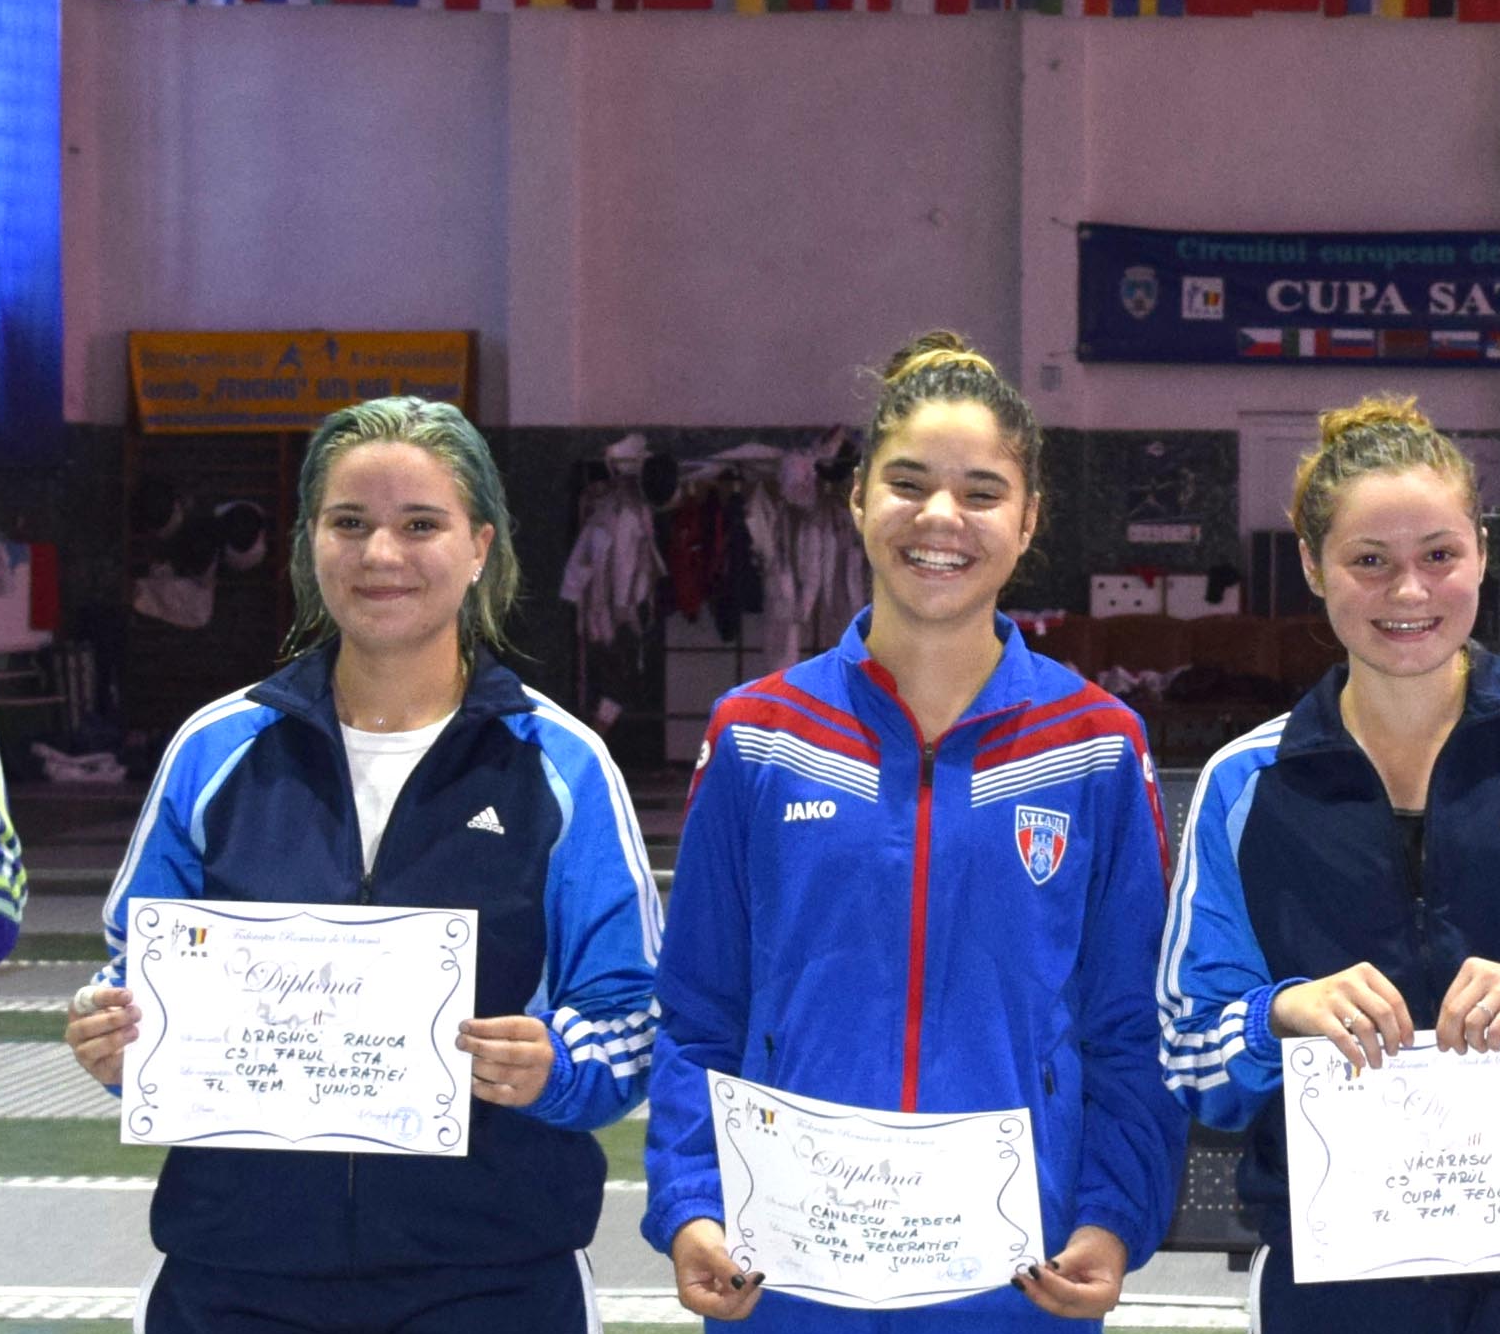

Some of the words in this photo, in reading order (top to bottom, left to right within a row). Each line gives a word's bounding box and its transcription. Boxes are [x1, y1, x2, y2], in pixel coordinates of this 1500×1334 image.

[1266, 279, 1411, 316] CUPA
[783, 800, 837, 822] JAKO
[343, 1032, 407, 1048] RALUCA
[224, 1047, 249, 1060] CS
[274, 1048, 324, 1062] FARUL
[351, 1052, 382, 1065] CTA
[235, 1063, 279, 1076] CUPA
[1385, 1175, 1411, 1189] CS
[1432, 1169, 1487, 1186] FARUL
[1402, 1188, 1443, 1205] CUPA
[808, 1217, 836, 1232] CSA
[862, 1228, 919, 1241] STEAUA
[814, 1234, 849, 1248] CUPA
